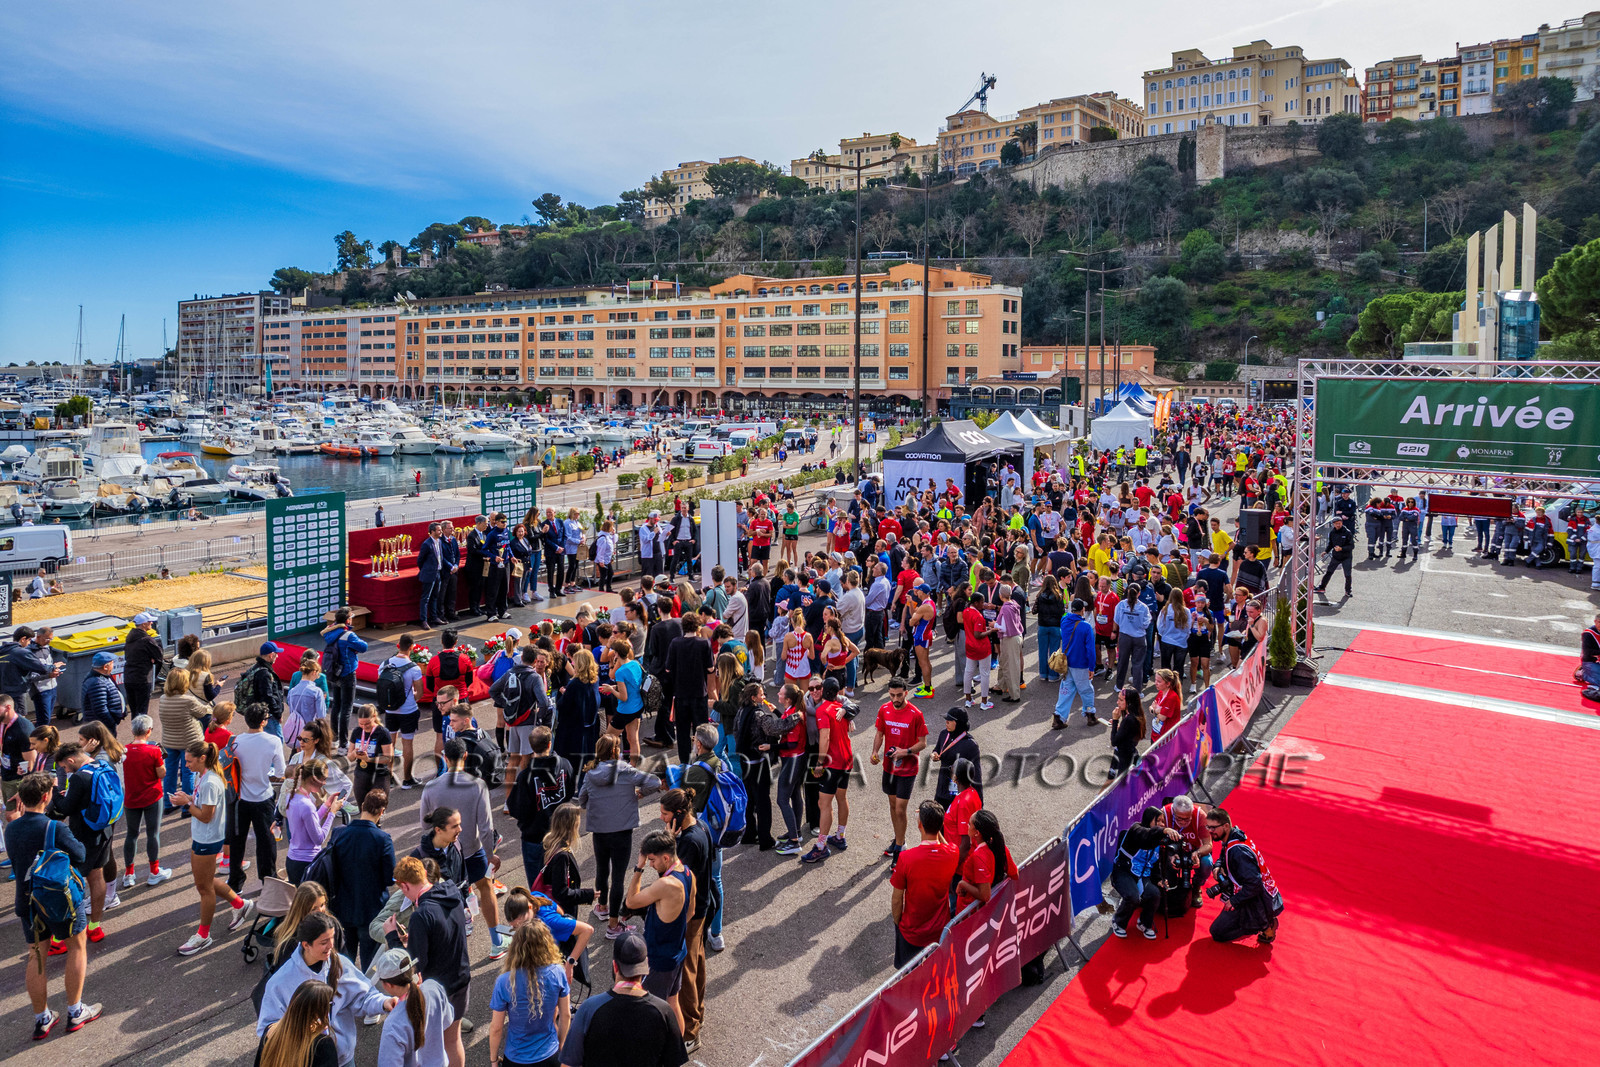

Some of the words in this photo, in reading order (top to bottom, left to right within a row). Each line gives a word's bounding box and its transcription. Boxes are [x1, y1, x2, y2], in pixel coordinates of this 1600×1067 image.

[1399, 396, 1574, 430] Arrivée
[1400, 445, 1426, 453] 42K
[1471, 448, 1514, 457] MONAFRAIS
[896, 477, 922, 489] ACT
[965, 860, 1066, 965] CYCLE
